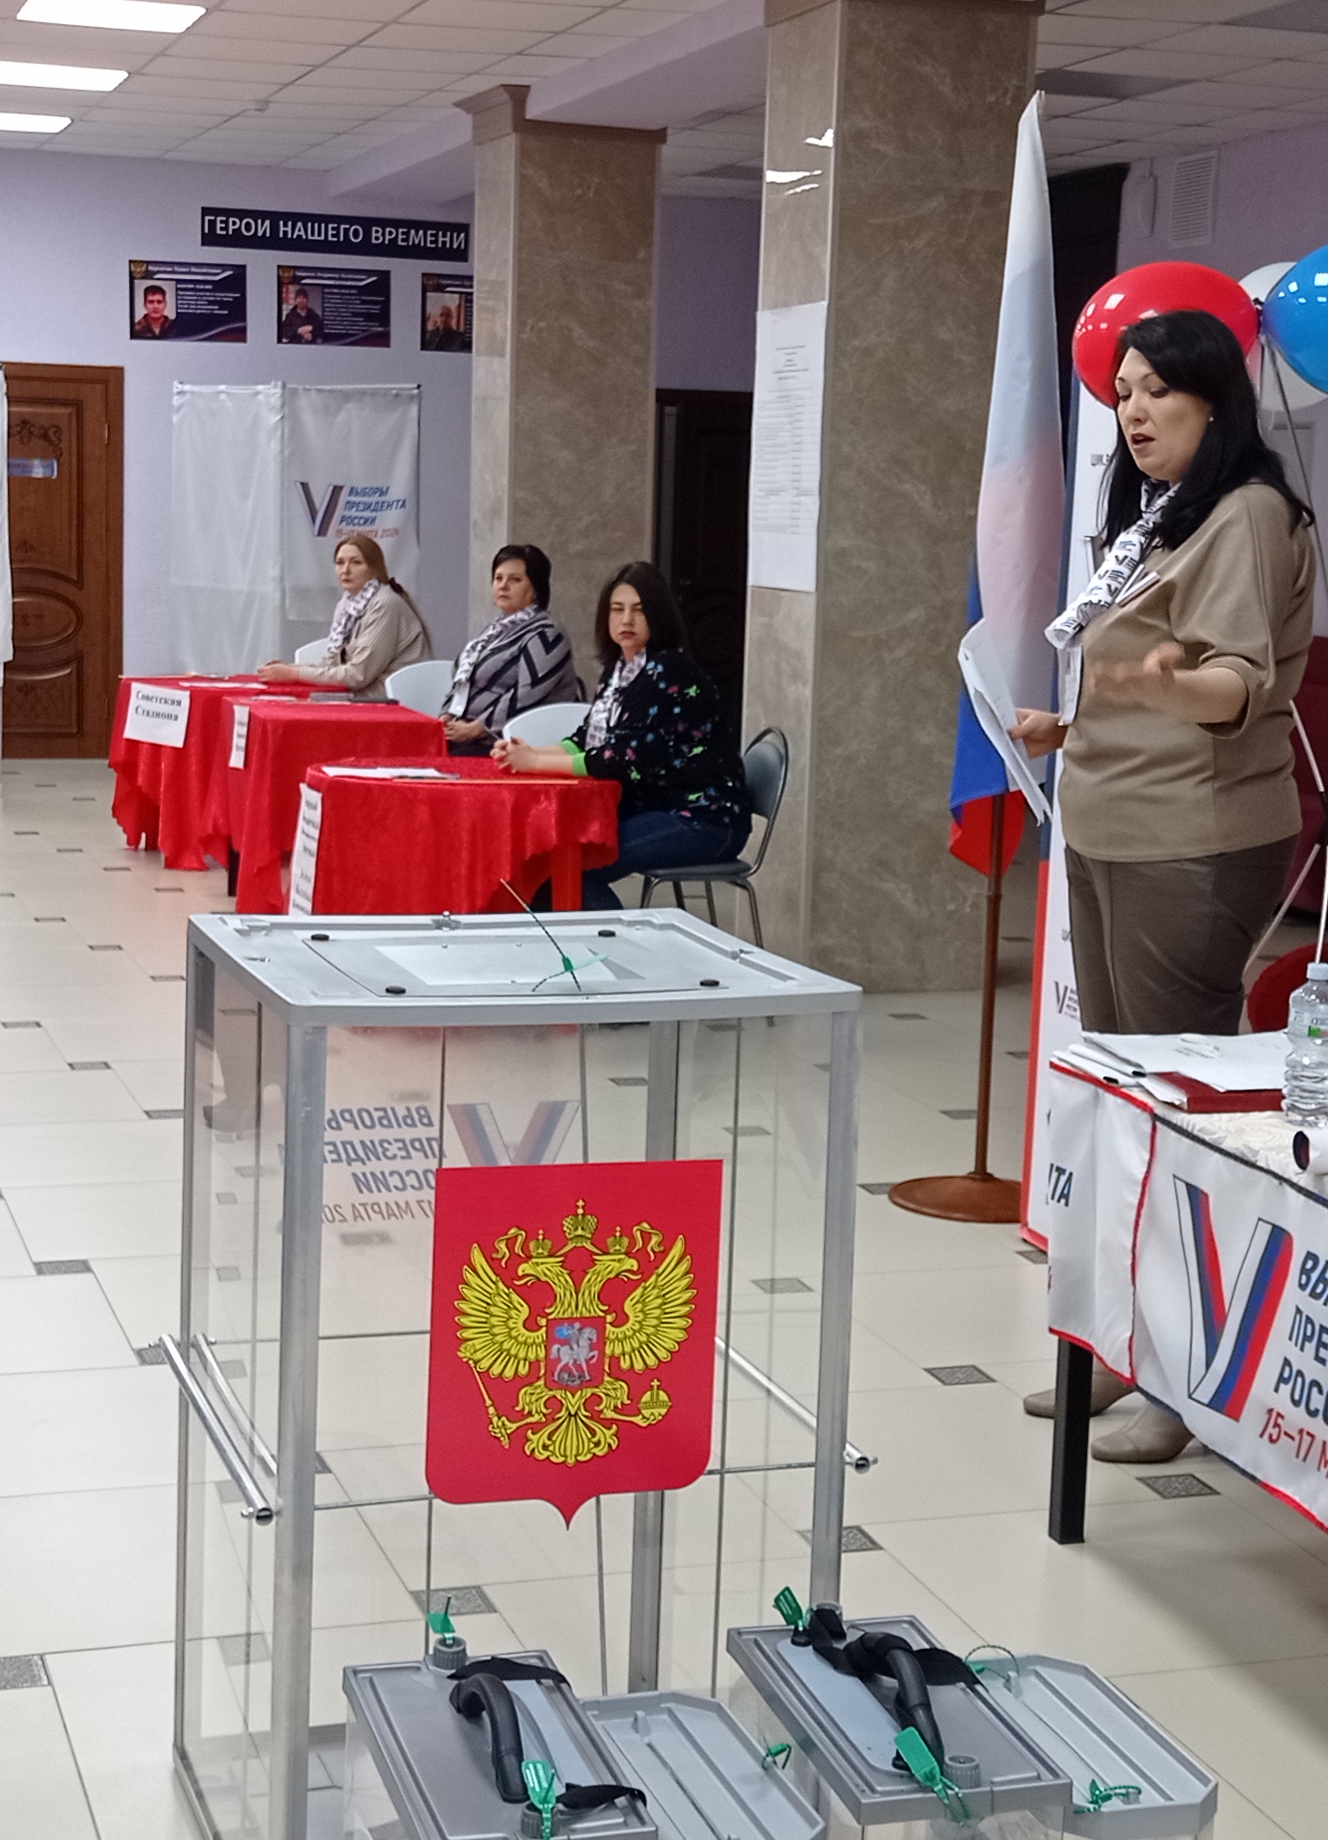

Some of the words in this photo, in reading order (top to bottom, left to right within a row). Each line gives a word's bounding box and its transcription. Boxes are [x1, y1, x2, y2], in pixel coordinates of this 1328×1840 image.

[203, 215, 271, 237] ГЕРОИ
[278, 220, 363, 243] НАШЕГО
[371, 226, 466, 250] ВРЕМЕНИ
[348, 486, 391, 498] ВЫБОРЫ
[344, 499, 407, 513] ПРЕЗИДЕНТА
[339, 515, 378, 527] РОССИИ
[136, 690, 183, 707] Советская
